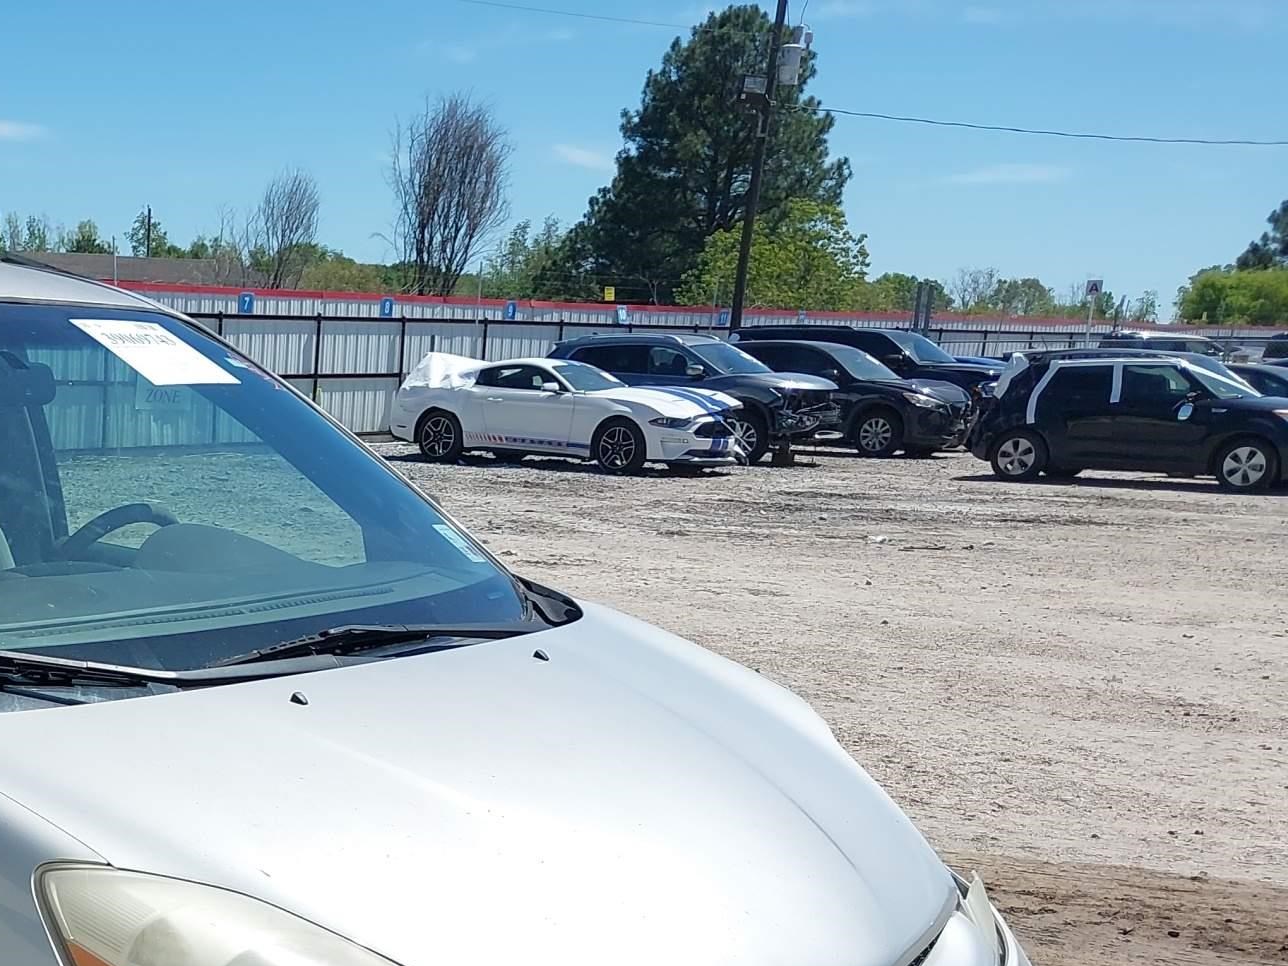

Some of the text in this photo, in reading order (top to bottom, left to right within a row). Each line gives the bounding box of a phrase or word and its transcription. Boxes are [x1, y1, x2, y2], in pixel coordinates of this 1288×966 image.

[1088, 282, 1099, 293] A
[244, 296, 251, 310] 7
[384, 300, 391, 314] 8
[508, 302, 514, 317] 9
[144, 388, 184, 404] ZONE
